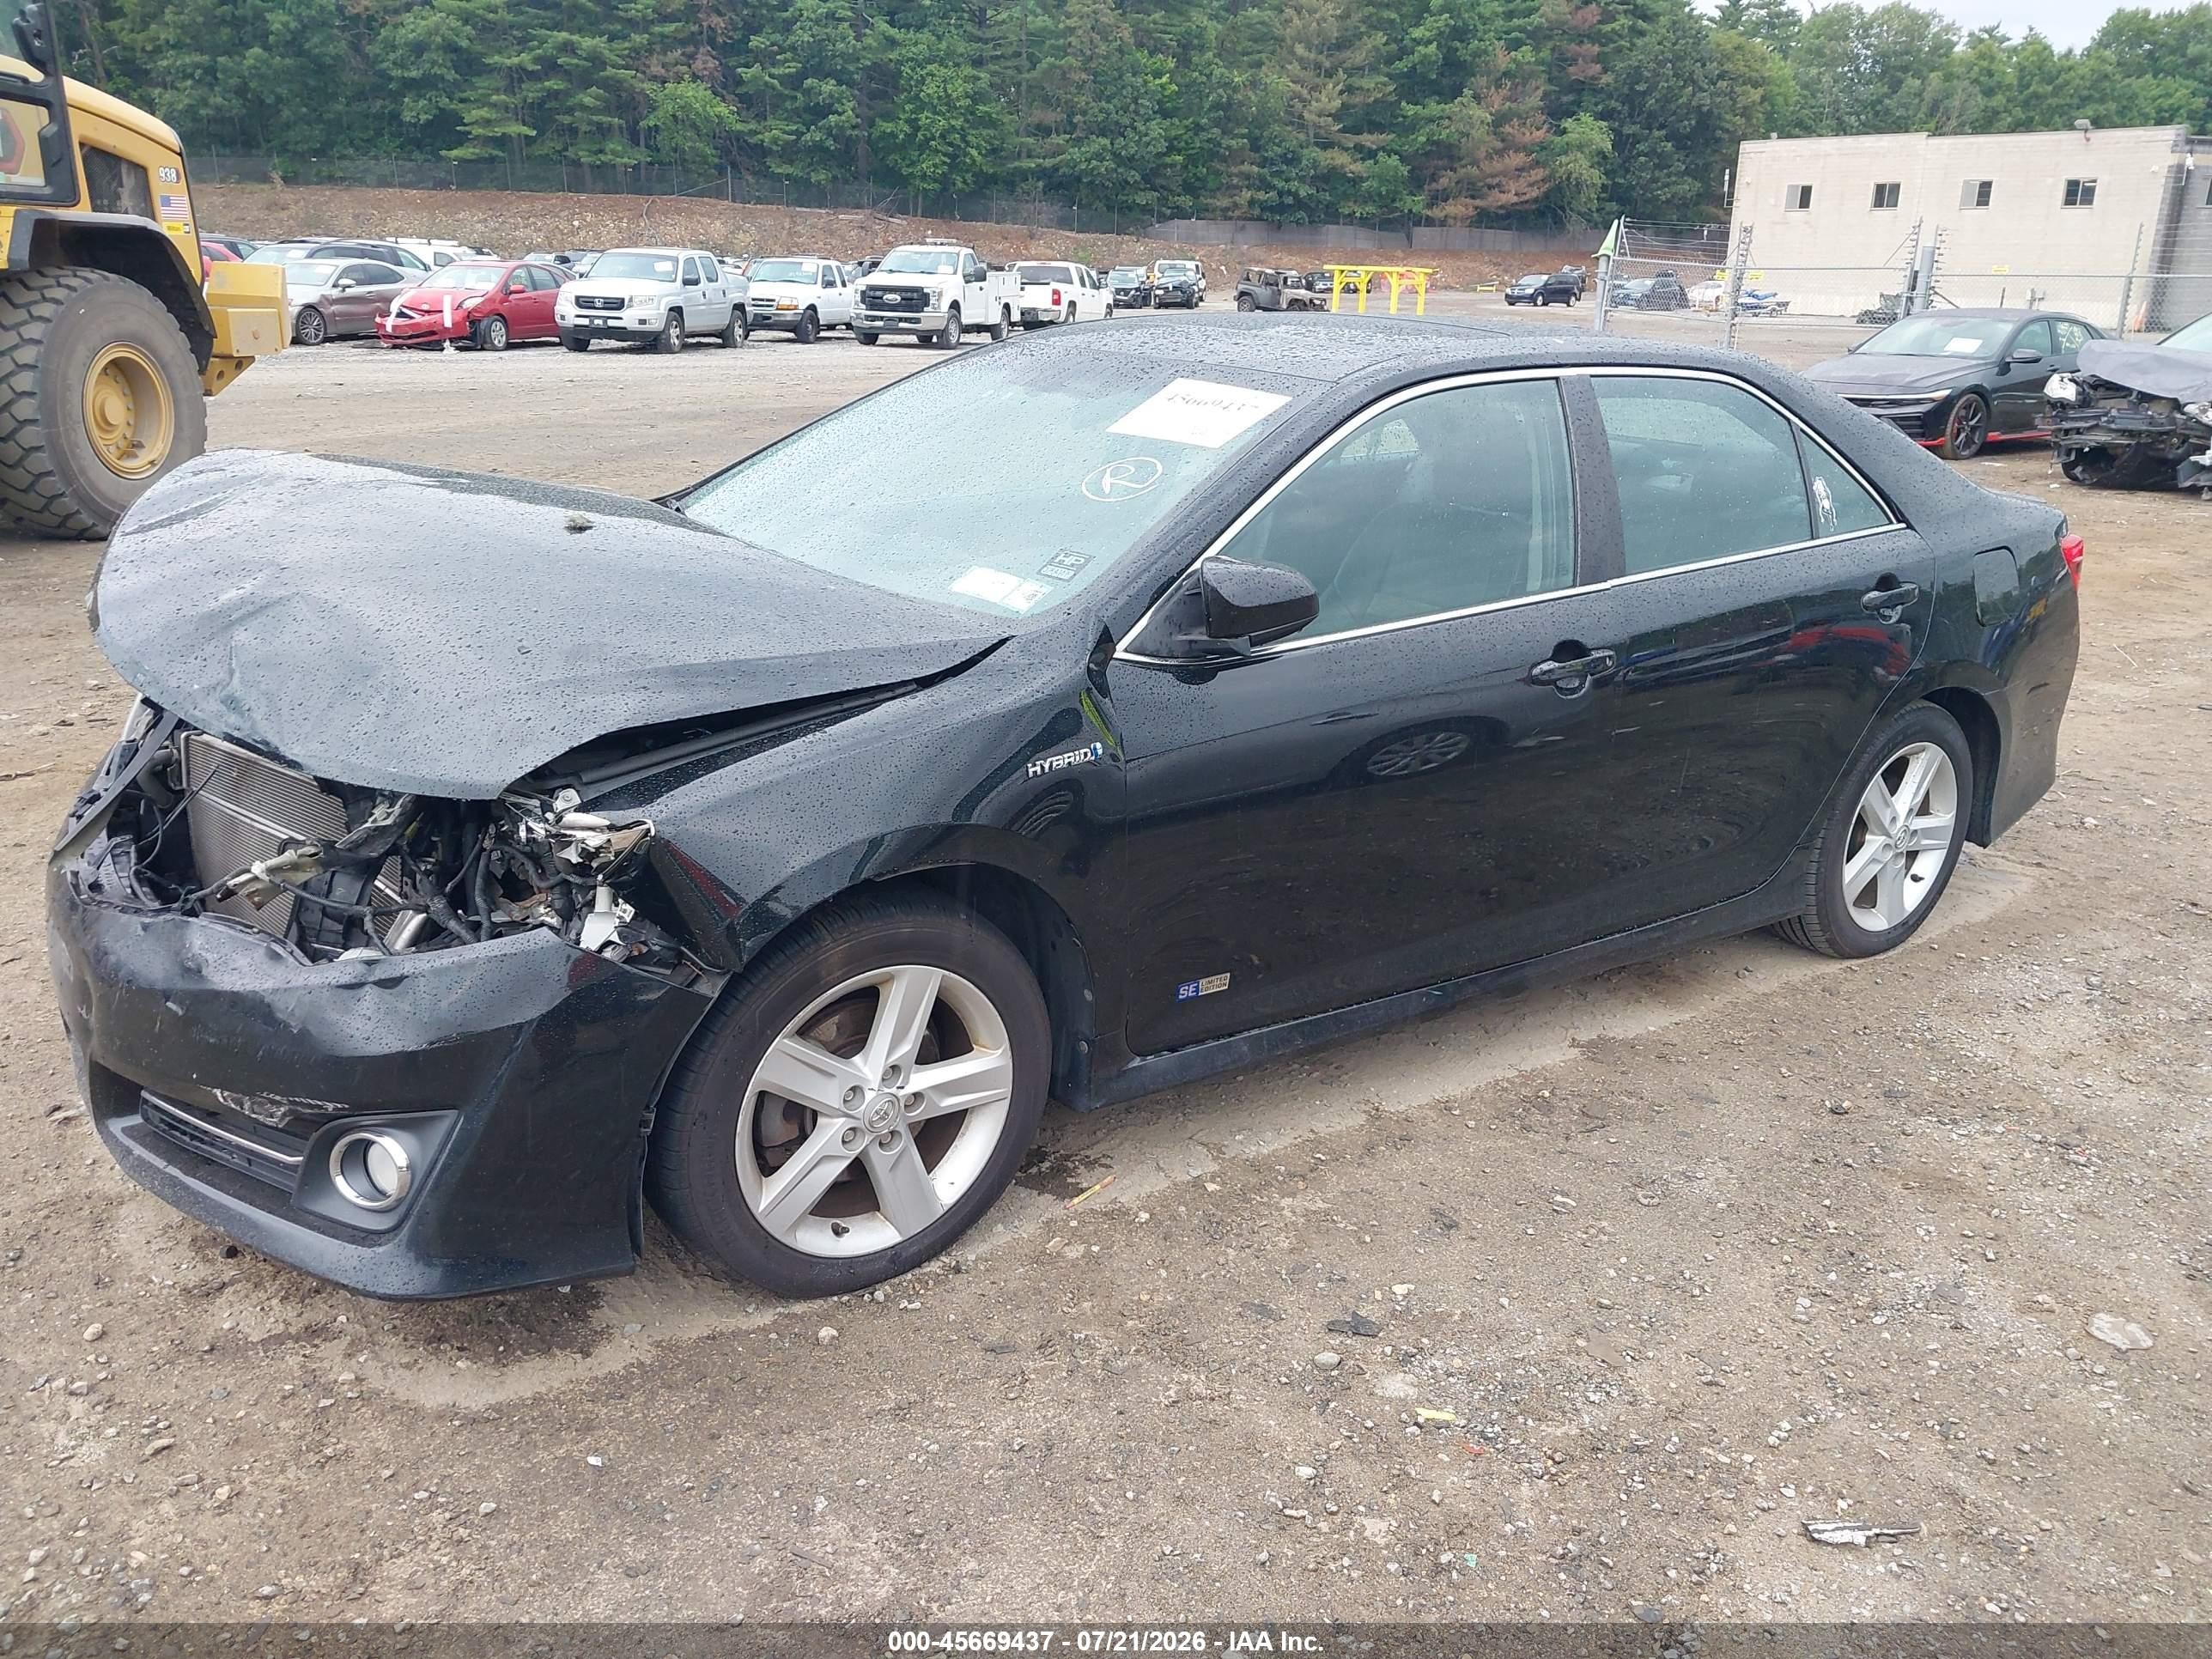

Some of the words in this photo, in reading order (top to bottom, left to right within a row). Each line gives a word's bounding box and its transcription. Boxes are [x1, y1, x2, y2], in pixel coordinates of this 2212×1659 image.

[159, 167, 178, 183] 938
[1026, 748, 1091, 778] HYBRID
[1200, 975, 1228, 987] LIMITED
[1200, 981, 1228, 994] EDITION
[1178, 983, 1199, 999] SE
